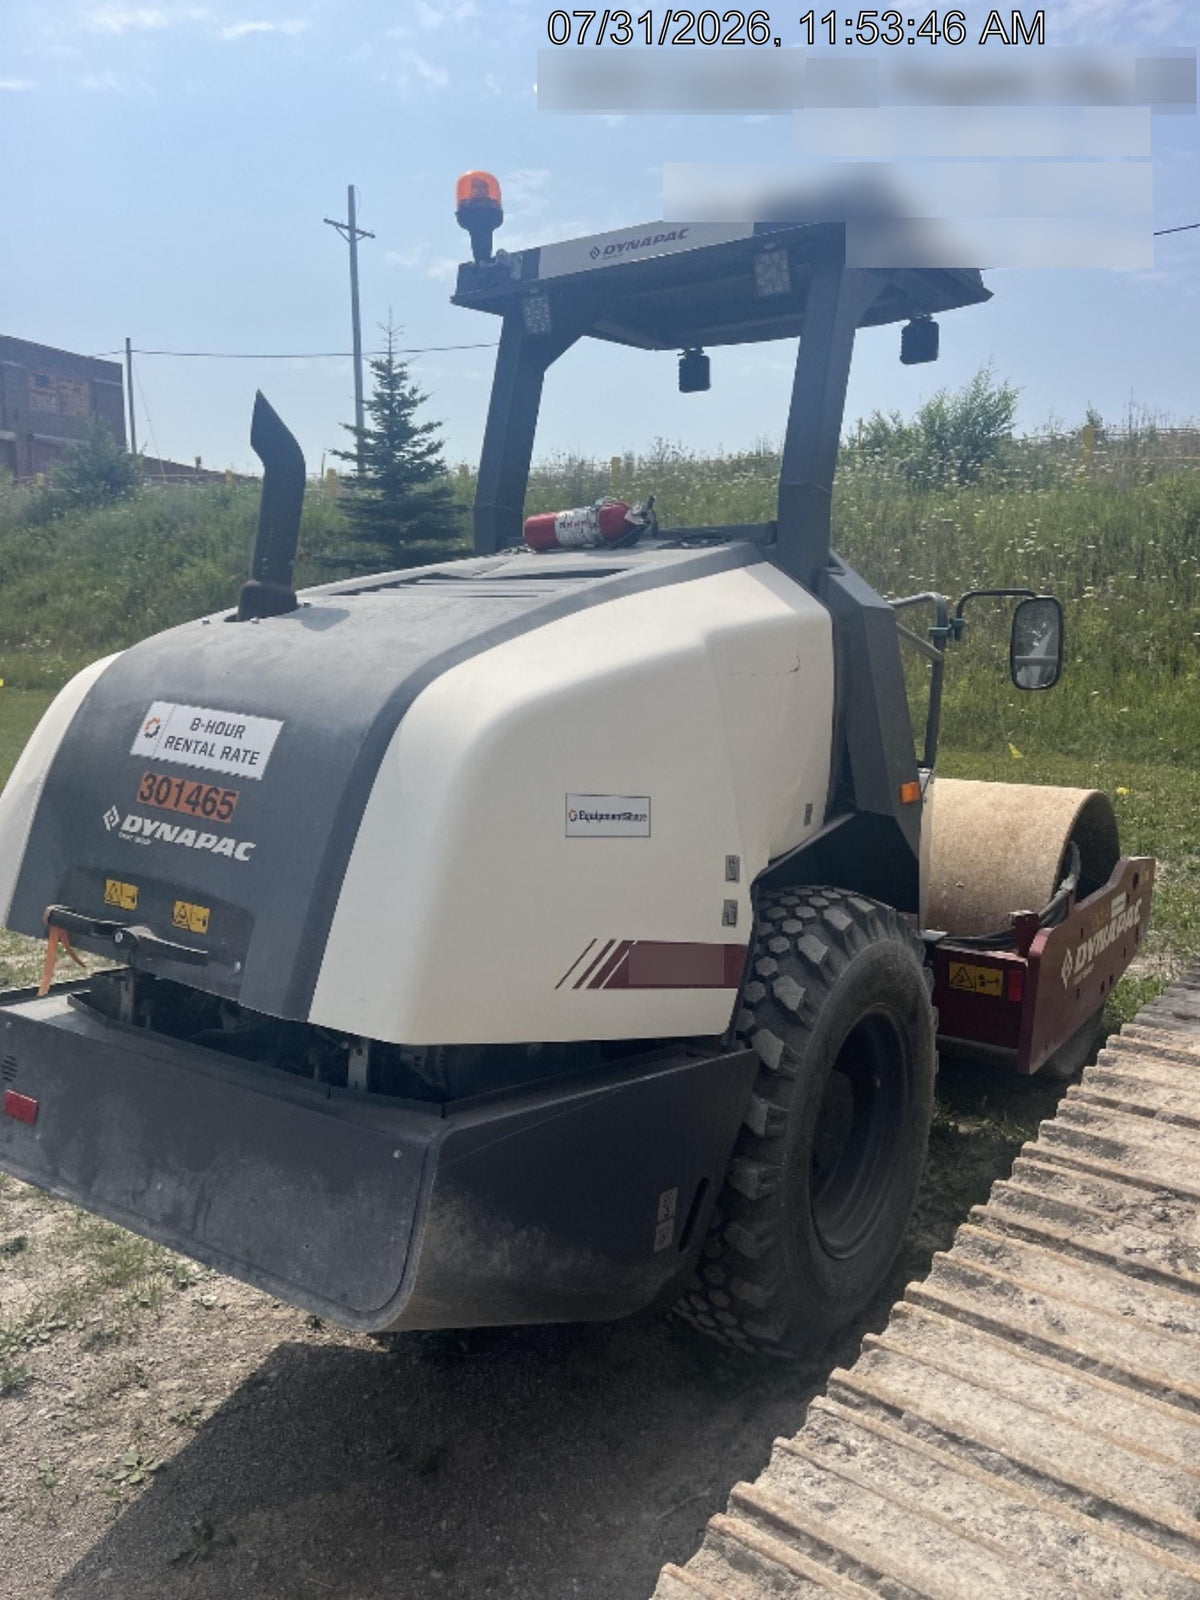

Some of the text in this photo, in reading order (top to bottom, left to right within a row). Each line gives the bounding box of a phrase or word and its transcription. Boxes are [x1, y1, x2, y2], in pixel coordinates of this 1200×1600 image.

[602, 227, 690, 256] DYNAPAC
[190, 717, 246, 740] 8-HOUR
[163, 735, 261, 765] RENTAL RATE
[139, 773, 237, 820] 301465
[120, 813, 257, 861] DYNAPAC
